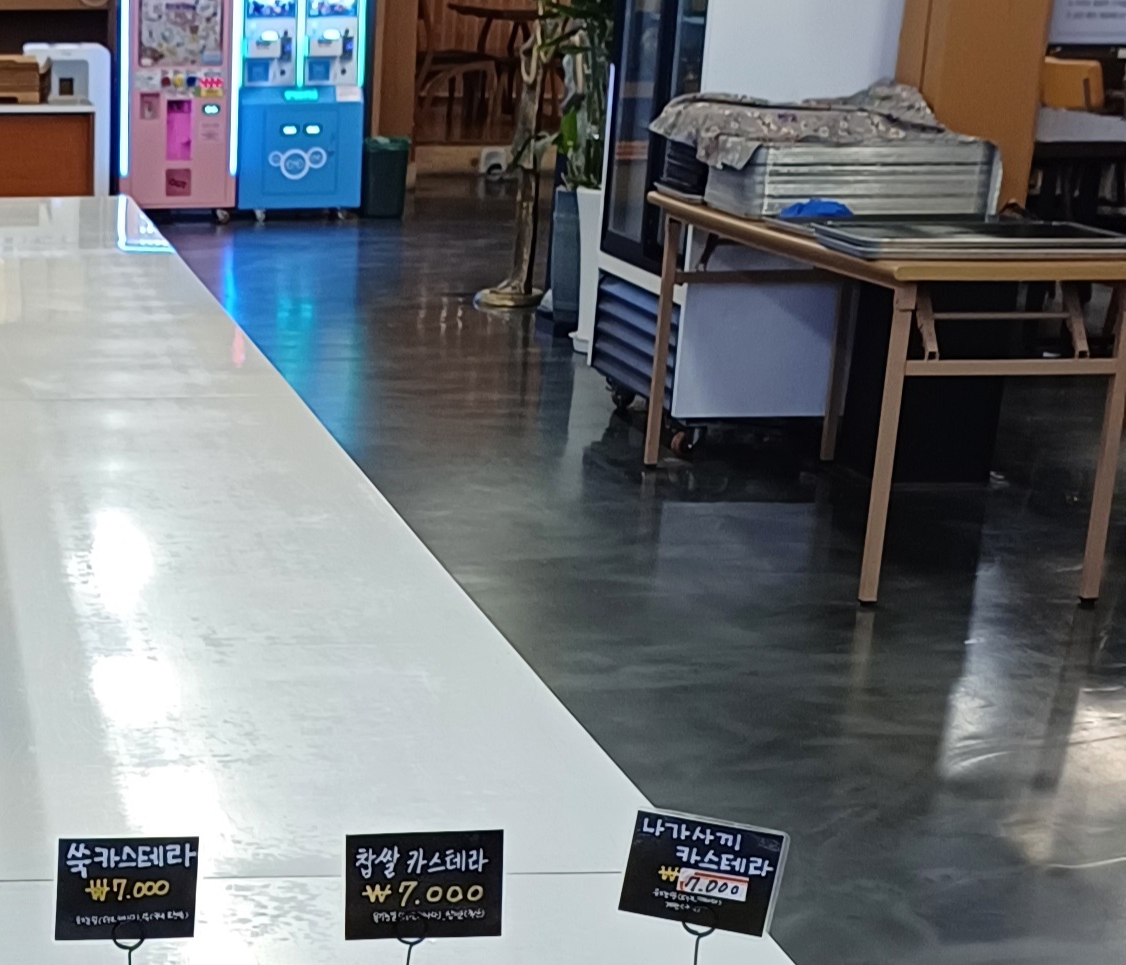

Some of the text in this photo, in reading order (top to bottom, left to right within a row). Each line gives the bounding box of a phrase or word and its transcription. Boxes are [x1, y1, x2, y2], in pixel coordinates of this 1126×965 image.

[642, 817, 742, 851] 나가사끼
[65, 842, 198, 879] 쑥카스테라
[355, 845, 489, 879] 찹쌀 카스테라
[675, 845, 775, 877] 카스테라
